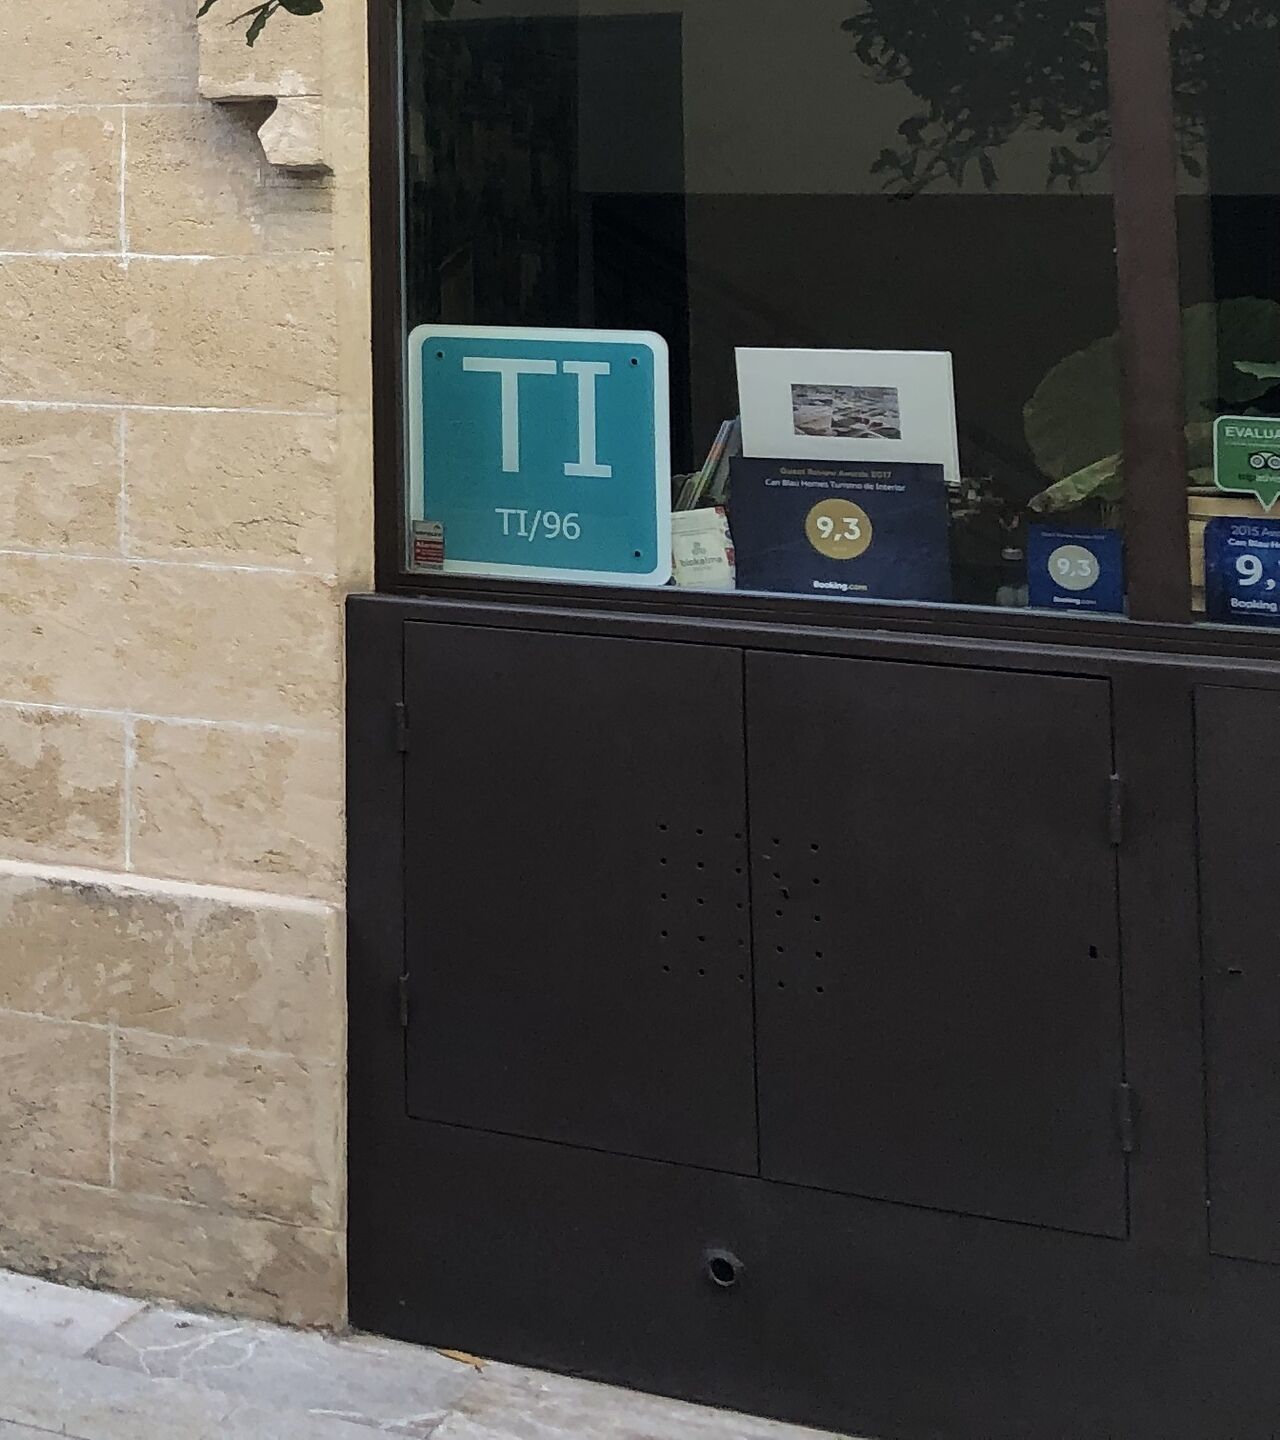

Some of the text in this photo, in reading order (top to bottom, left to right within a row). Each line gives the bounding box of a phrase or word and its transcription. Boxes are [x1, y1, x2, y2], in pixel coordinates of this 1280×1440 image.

[462, 356, 613, 479] TI
[494, 507, 582, 543] TI/96
[815, 516, 862, 542] 9,3
[1057, 557, 1092, 577] 9,3
